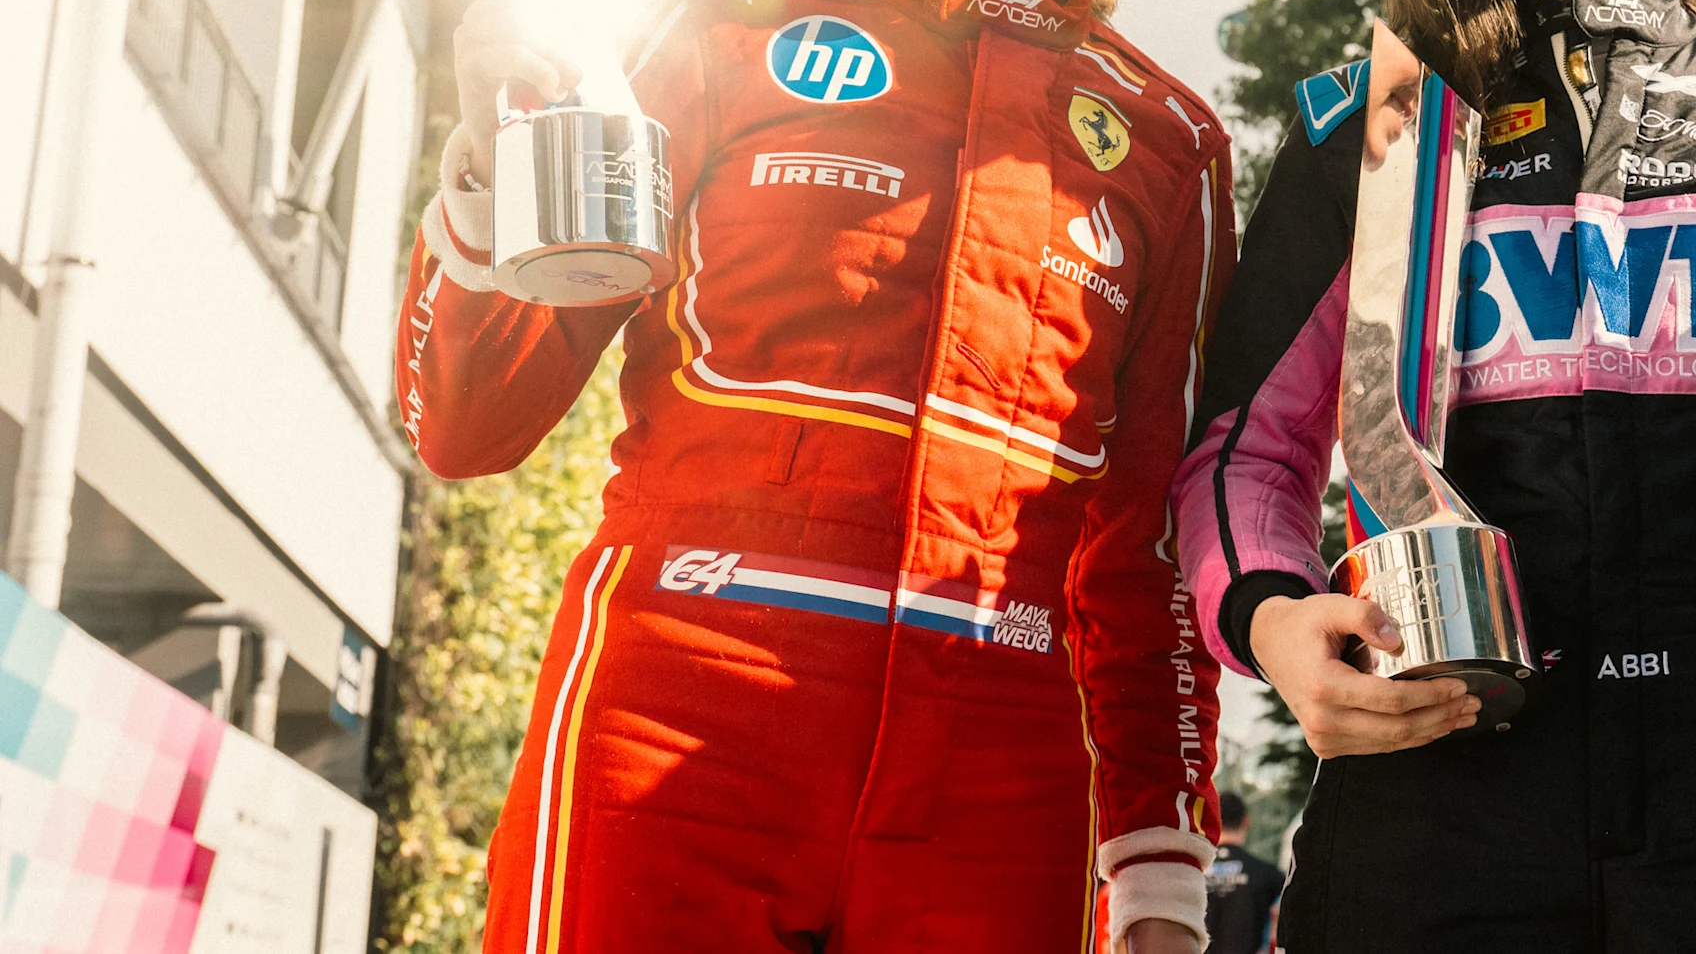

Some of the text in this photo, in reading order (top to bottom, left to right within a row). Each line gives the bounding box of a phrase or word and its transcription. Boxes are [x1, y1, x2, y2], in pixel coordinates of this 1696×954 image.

[1584, 4, 1666, 29] ACADEMY
[785, 20, 876, 102] hp
[749, 151, 906, 199] PIRELLI
[1040, 244, 1129, 315] Santander
[1467, 357, 1553, 389] WATER
[659, 549, 742, 596] 64
[1003, 599, 1051, 629] MAYA
[992, 623, 1052, 654] WEUG
[1597, 650, 1670, 680] ABBI
[1177, 704, 1203, 786] MILLE
